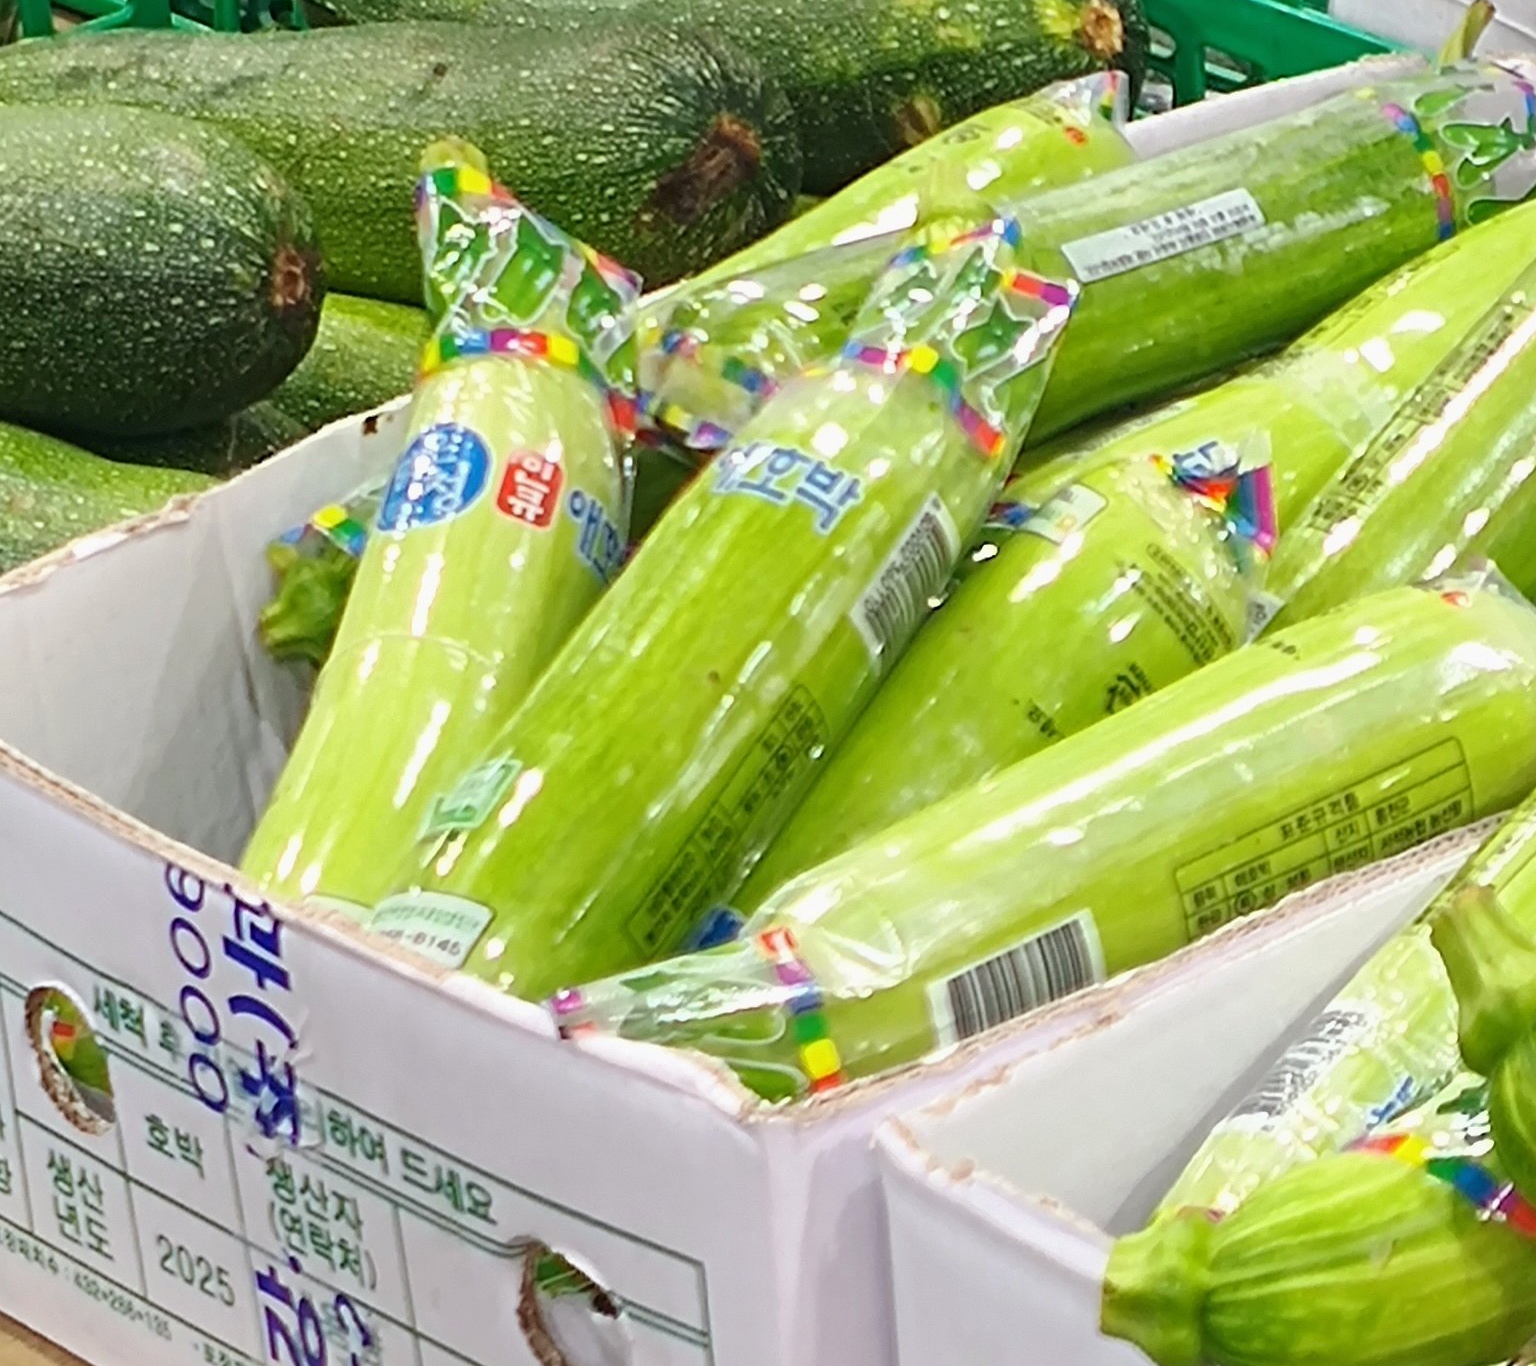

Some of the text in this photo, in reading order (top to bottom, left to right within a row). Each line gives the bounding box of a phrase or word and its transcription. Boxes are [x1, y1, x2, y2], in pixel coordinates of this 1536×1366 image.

[144, 1112, 206, 1180] 호박
[400, 1147, 499, 1227] 드세요
[156, 1233, 236, 1308] 2025
